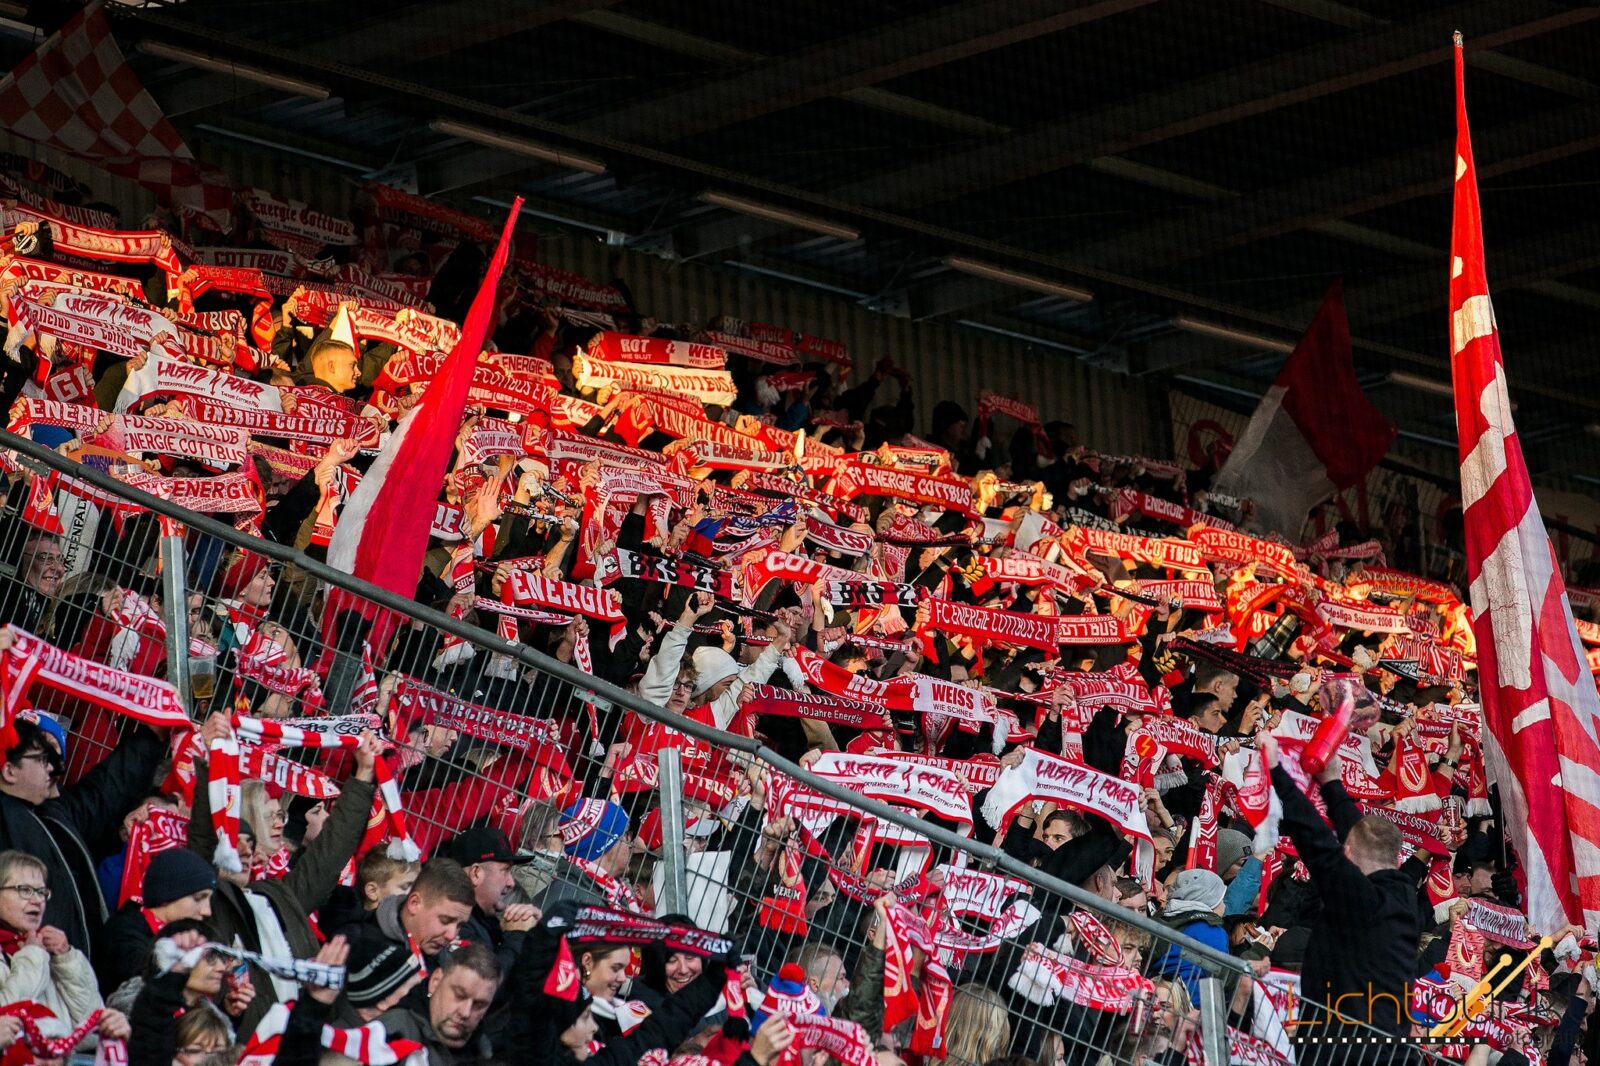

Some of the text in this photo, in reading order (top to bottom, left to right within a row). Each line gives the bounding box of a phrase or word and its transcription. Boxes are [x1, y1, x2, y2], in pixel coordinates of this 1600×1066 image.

[214, 251, 289, 274] COTTBUS
[619, 338, 650, 353] ROT
[501, 355, 545, 374] ENERGIE
[123, 414, 239, 446] FUSSBALLCLUB
[203, 403, 348, 437] ENERGIE COTTBUS
[123, 431, 247, 465] ENERGIE COTTBUS
[172, 480, 251, 500] ENERGI
[847, 466, 972, 508] FC ENERGIE COTTBUS
[1088, 529, 1201, 565] ENERGIE COTTBUS
[1255, 542, 1295, 567] COTT
[511, 568, 621, 618] ENERGIE
[936, 601, 950, 624] FC
[950, 603, 989, 631] ENERGIE
[991, 612, 1035, 639] COTTBUS
[752, 682, 770, 700] FC
[846, 673, 891, 697] ROT
[931, 682, 975, 710] WEISS
[797, 705, 864, 724] 40 Jahre Energie
[932, 702, 946, 713] WIE
[946, 705, 975, 719] SCHNEE
[832, 759, 969, 804] LAUSITZ POWER
[1035, 758, 1088, 789] LAUSITZ
[1098, 779, 1139, 811] POWER
